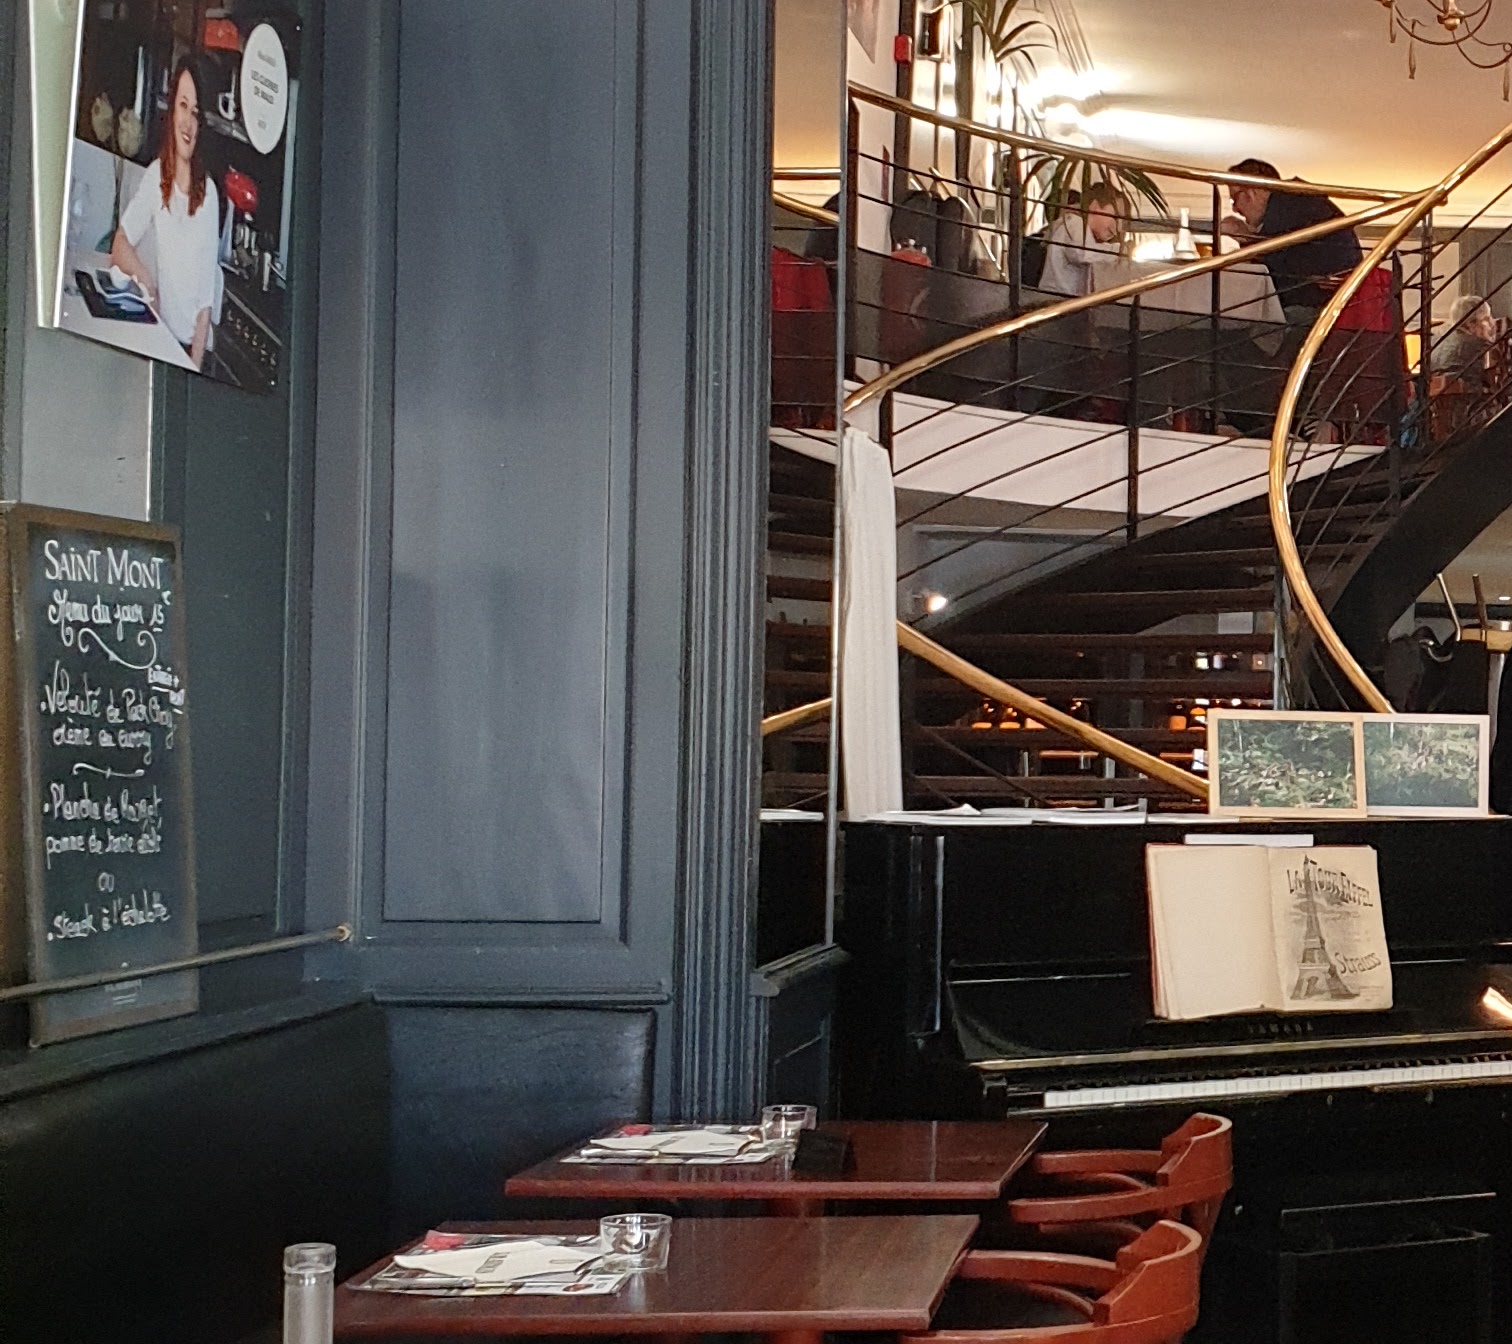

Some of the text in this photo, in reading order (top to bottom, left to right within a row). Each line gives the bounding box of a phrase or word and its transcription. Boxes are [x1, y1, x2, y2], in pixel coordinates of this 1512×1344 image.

[107, 546, 164, 590] MONT
[92, 594, 112, 624] du
[114, 604, 144, 642] jour
[1334, 952, 1382, 975] Strauss
